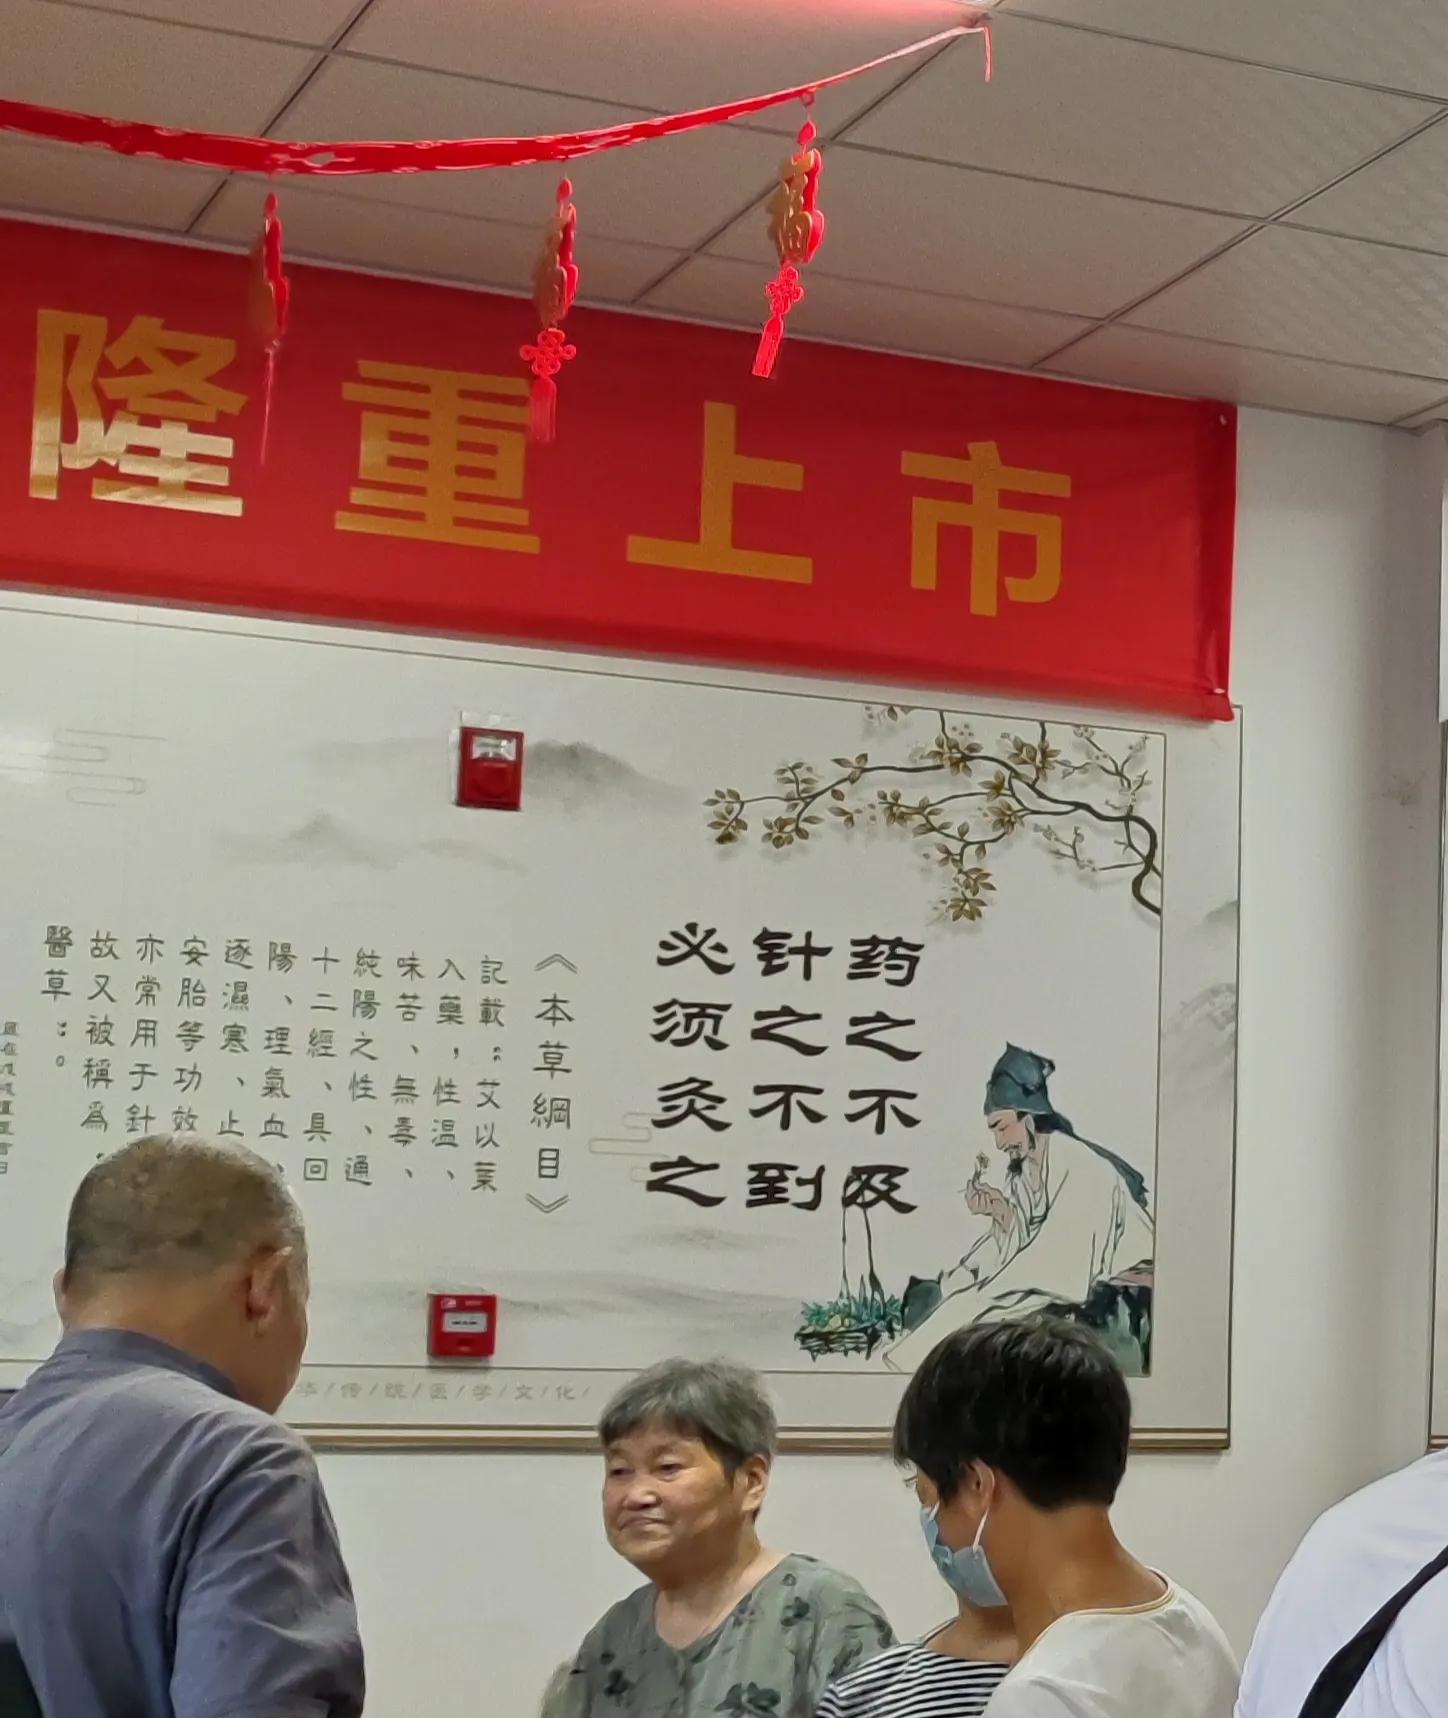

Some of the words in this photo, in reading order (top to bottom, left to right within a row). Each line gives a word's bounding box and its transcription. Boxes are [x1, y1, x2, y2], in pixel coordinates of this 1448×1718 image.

[28, 308, 1073, 617] 隆重上市
[646, 920, 736, 1208] 必须灸之
[745, 926, 833, 1211] 针之不到
[844, 933, 925, 1214] 药之不及
